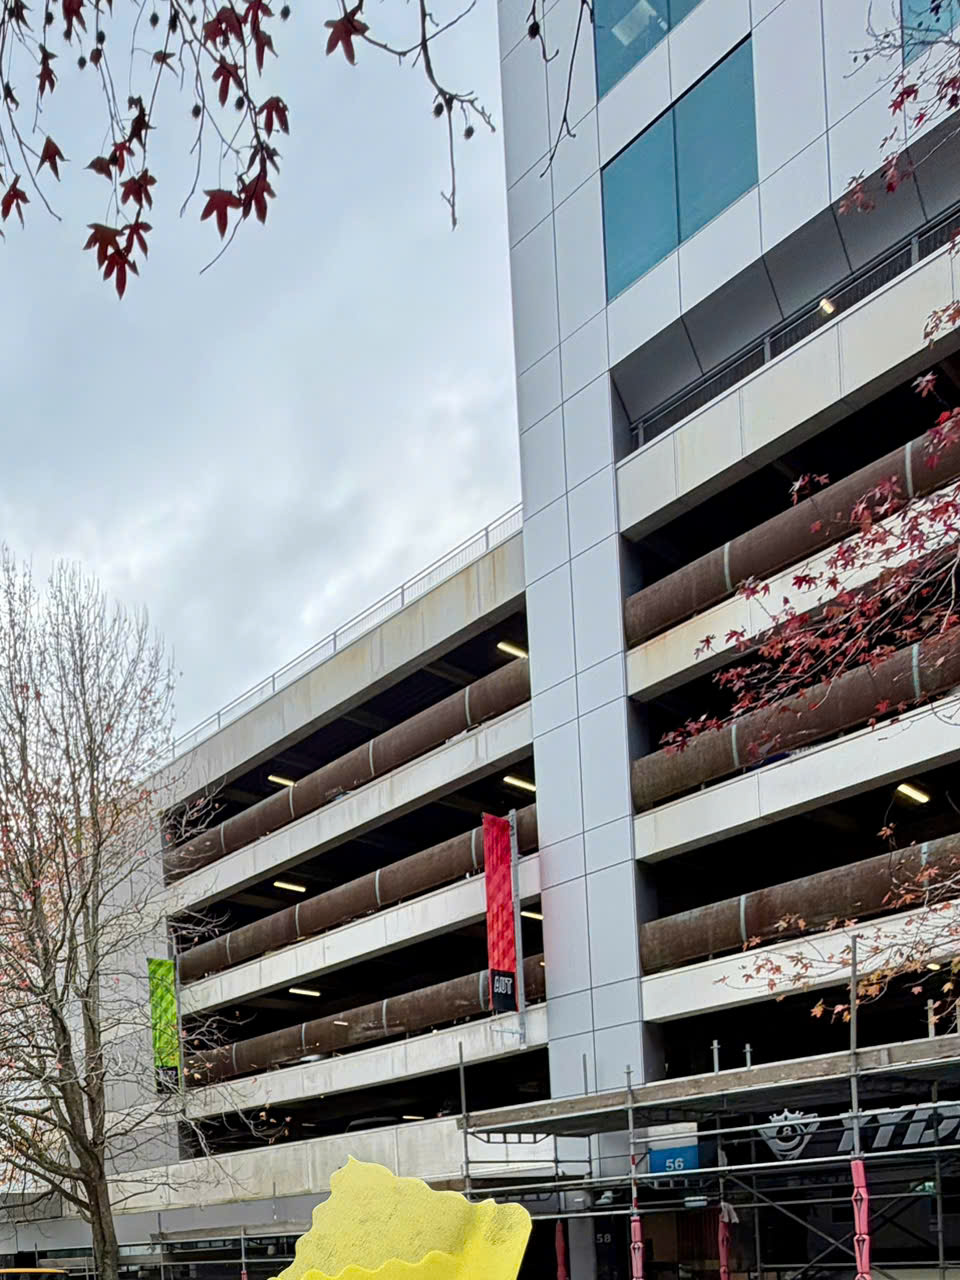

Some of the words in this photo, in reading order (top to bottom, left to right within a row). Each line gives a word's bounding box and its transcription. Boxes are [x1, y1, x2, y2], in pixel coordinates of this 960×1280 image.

[493, 975, 513, 995] AUT
[665, 1158, 685, 1171] 56
[596, 1233, 612, 1244] 58
